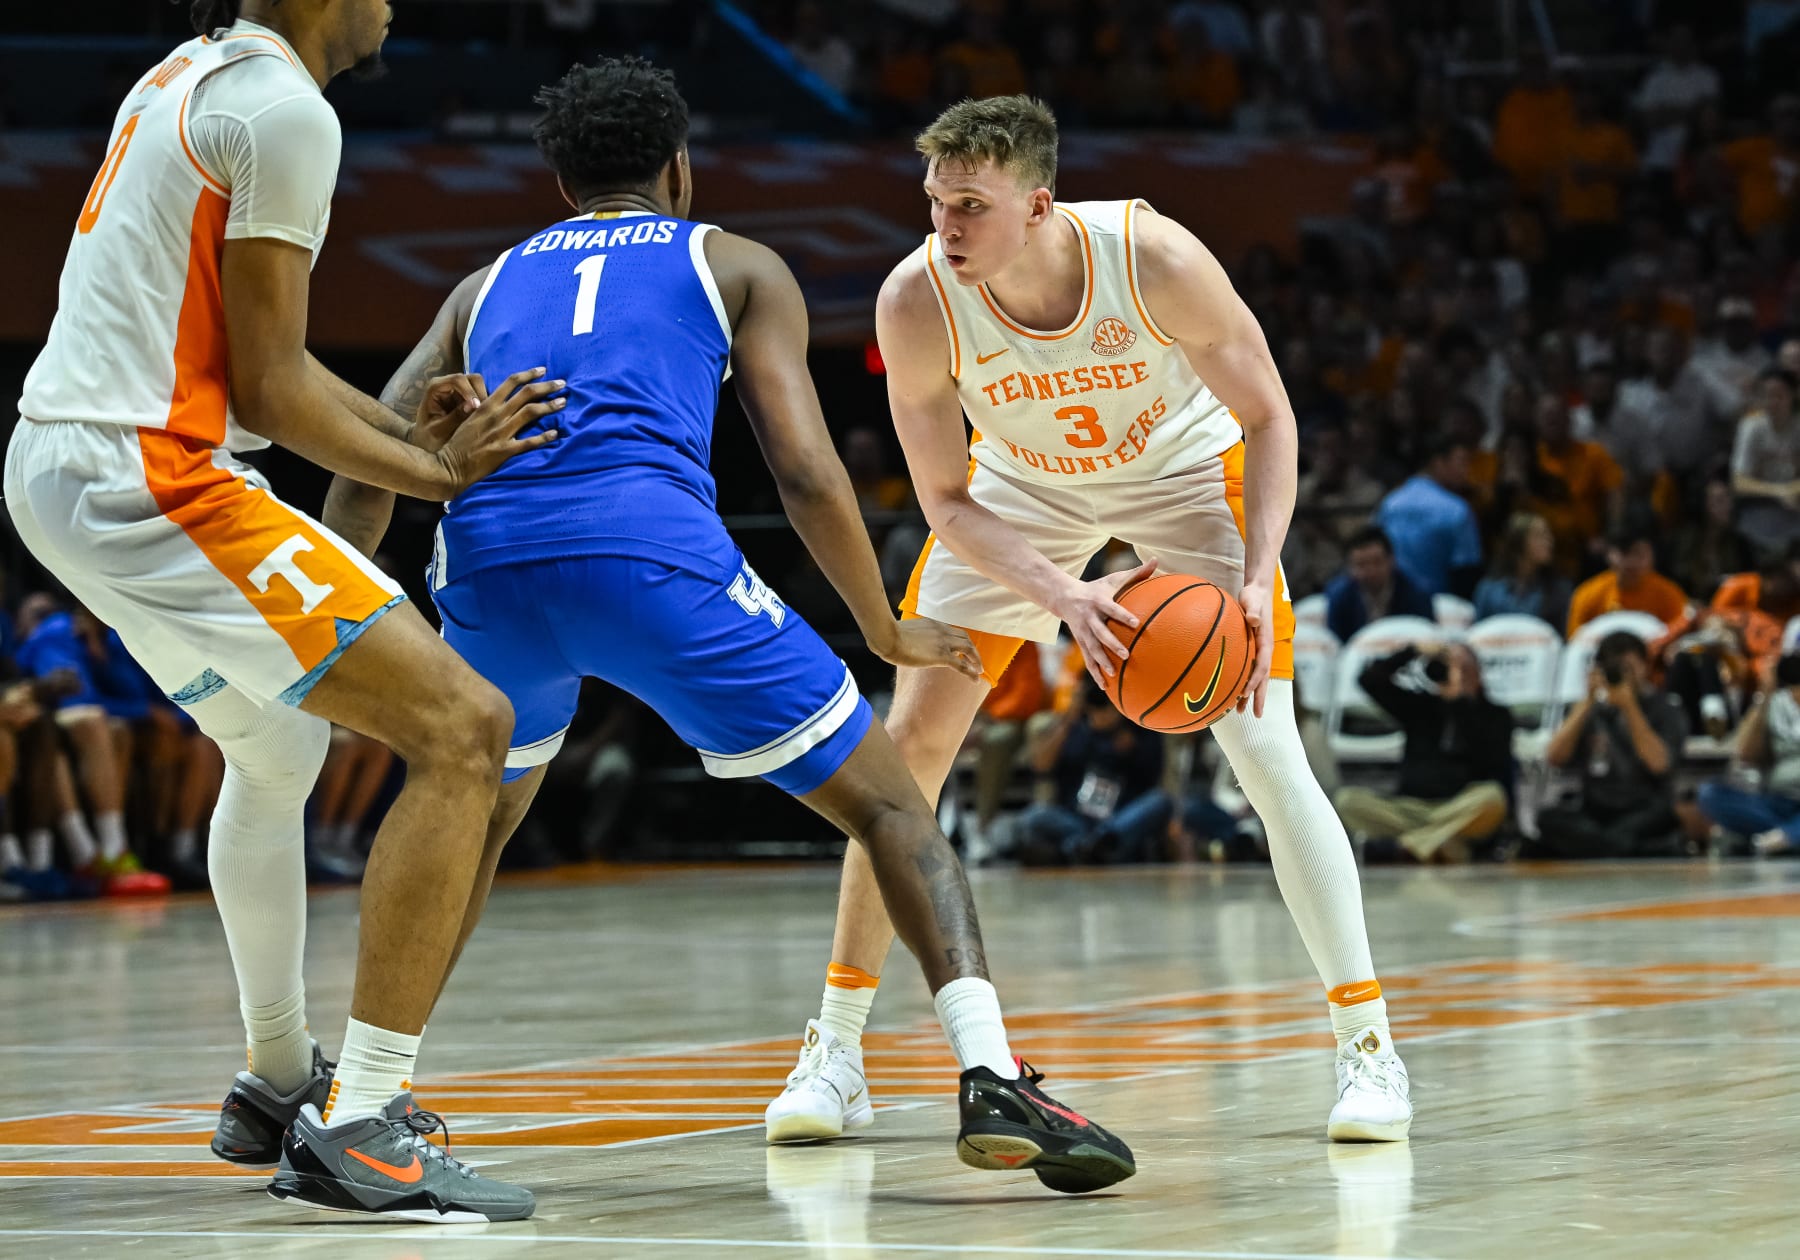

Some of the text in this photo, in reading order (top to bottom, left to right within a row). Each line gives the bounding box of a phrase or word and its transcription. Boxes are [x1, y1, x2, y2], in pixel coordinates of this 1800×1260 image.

[521, 221, 678, 257] EDWARDS
[572, 254, 608, 336] 1
[1096, 319, 1127, 346] SEC
[1097, 334, 1136, 356] GRADUATE
[982, 361, 1150, 407] TENNESSEE
[1003, 395, 1167, 475] VOLUNTEERS
[1054, 405, 1108, 449] 3
[247, 533, 335, 616] T
